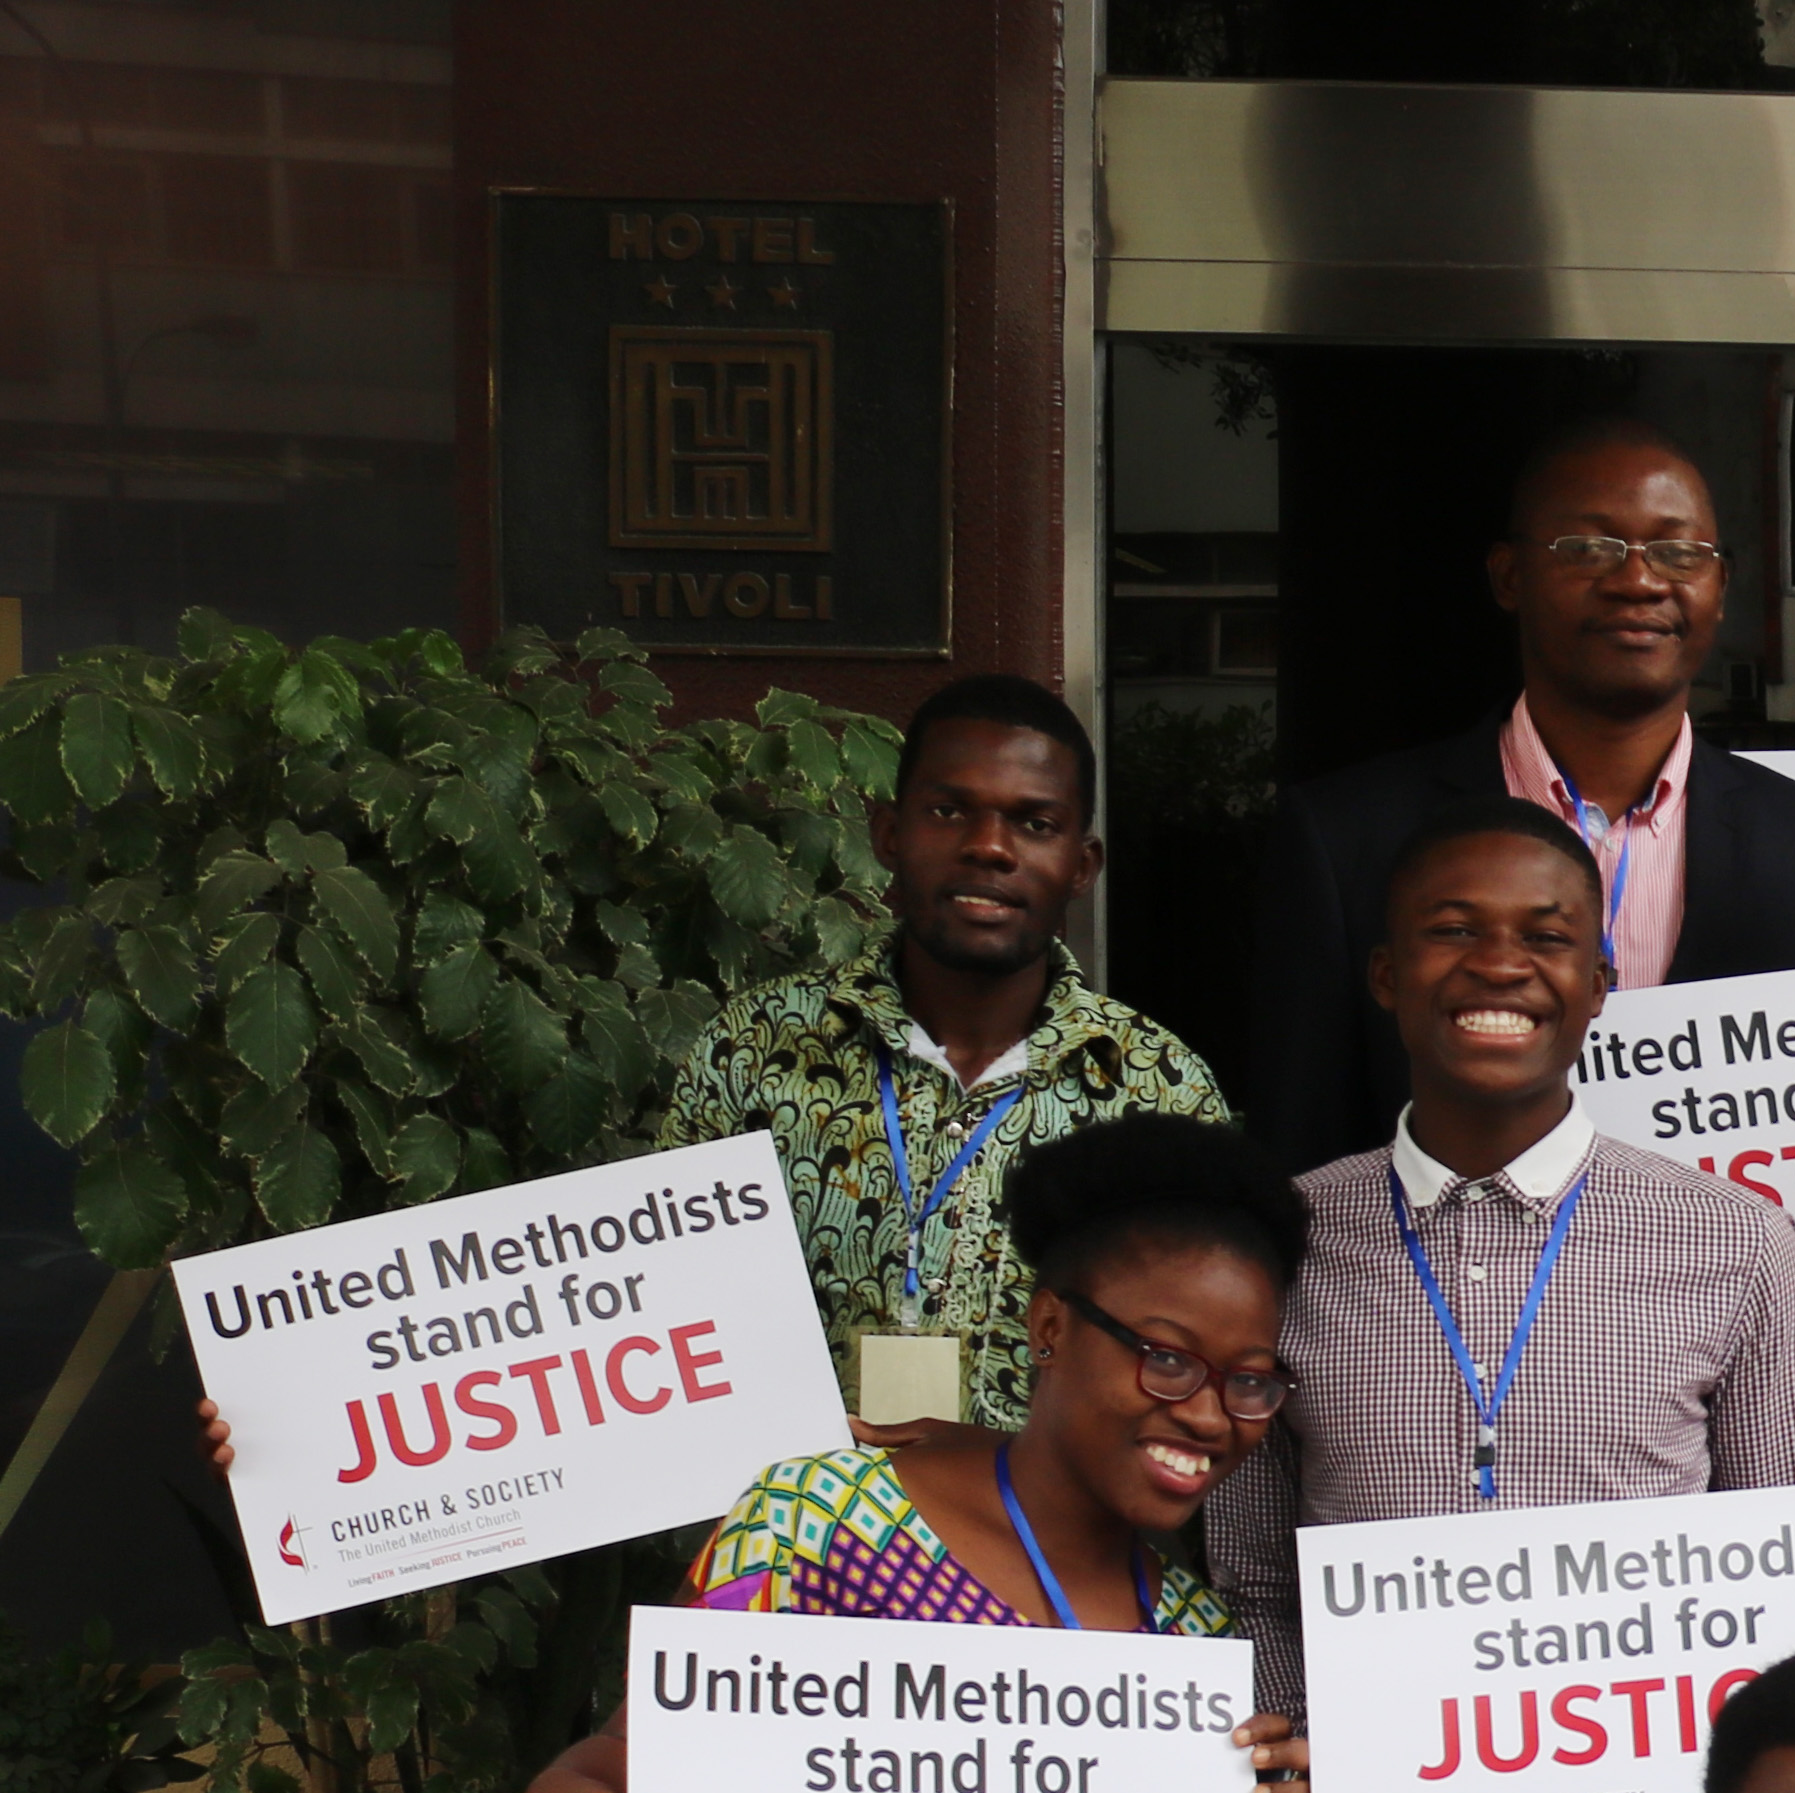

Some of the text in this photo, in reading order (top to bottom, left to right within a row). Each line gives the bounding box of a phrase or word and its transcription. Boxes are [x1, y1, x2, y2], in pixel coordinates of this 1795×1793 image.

[607, 213, 835, 265] HOTEL
[608, 571, 834, 620] TIVOLI
[204, 1181, 768, 1338] United Methodists
[366, 1273, 644, 1370] stand for
[337, 1320, 732, 1483] JUSTICE
[332, 1468, 562, 1542] CHURCH & SOCIETY
[1323, 1548, 1531, 1617] United
[1474, 1598, 1765, 1670] stand for
[654, 1651, 1232, 1732] United Methodists
